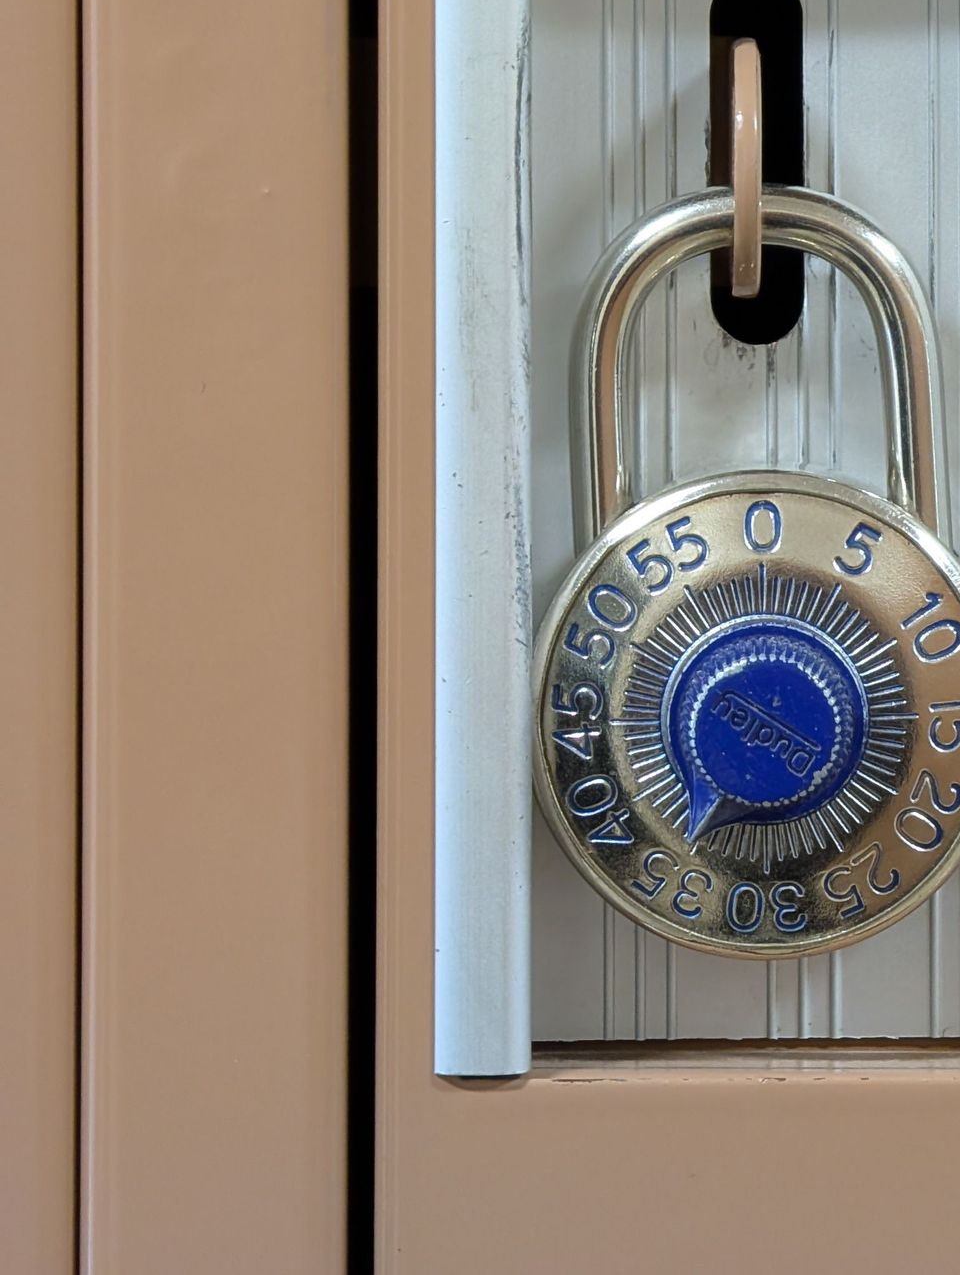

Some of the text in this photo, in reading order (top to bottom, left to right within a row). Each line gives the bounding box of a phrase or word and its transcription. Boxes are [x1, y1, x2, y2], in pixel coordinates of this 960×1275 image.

[626, 516, 709, 596] 55
[743, 500, 783, 553] 0
[832, 521, 884, 576] 5
[563, 583, 638, 669] 50
[551, 681, 605, 760] 45
[711, 690, 818, 778] Dudley
[566, 774, 635, 846] 40
[631, 849, 713, 921] 35
[727, 882, 808, 933] 30
[823, 841, 900, 921] 25
